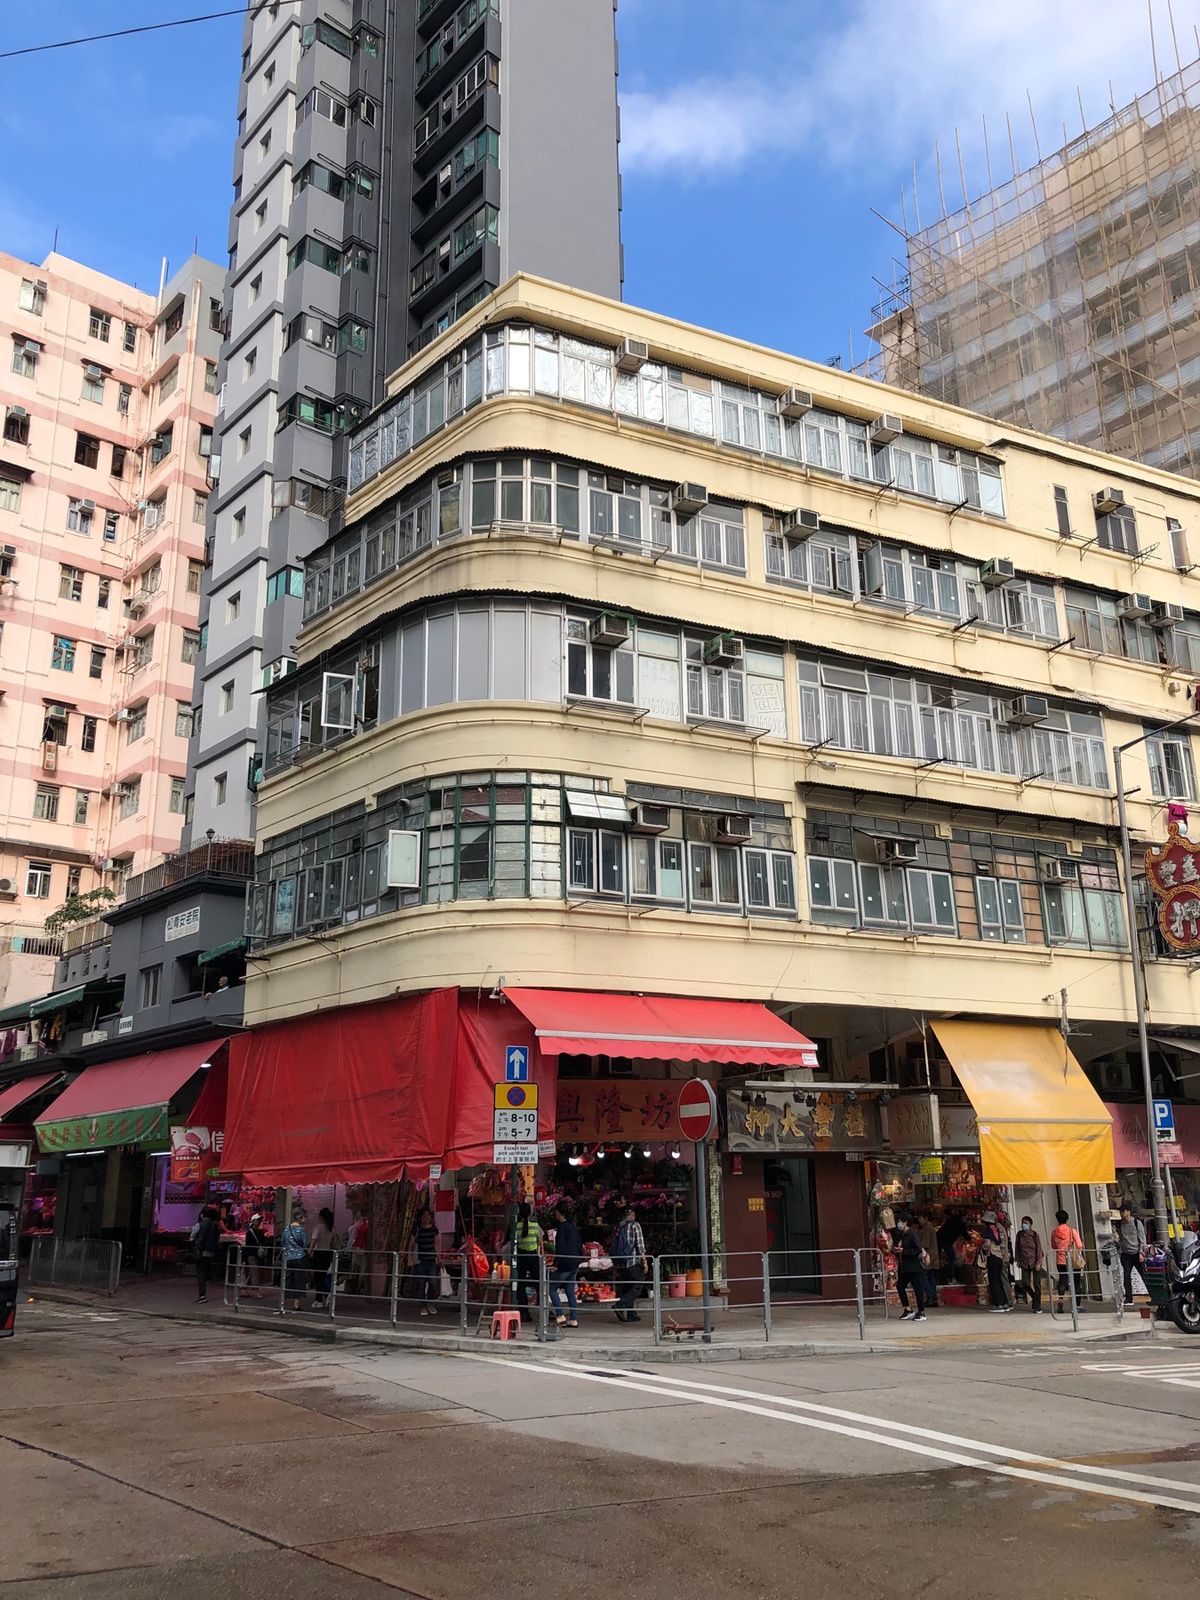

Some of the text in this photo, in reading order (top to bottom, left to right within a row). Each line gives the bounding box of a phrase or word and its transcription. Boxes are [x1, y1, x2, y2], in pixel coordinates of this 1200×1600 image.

[511, 1113, 536, 1123] 8-10
[1154, 1104, 1169, 1126] P
[511, 1128, 531, 1137] 5-7
